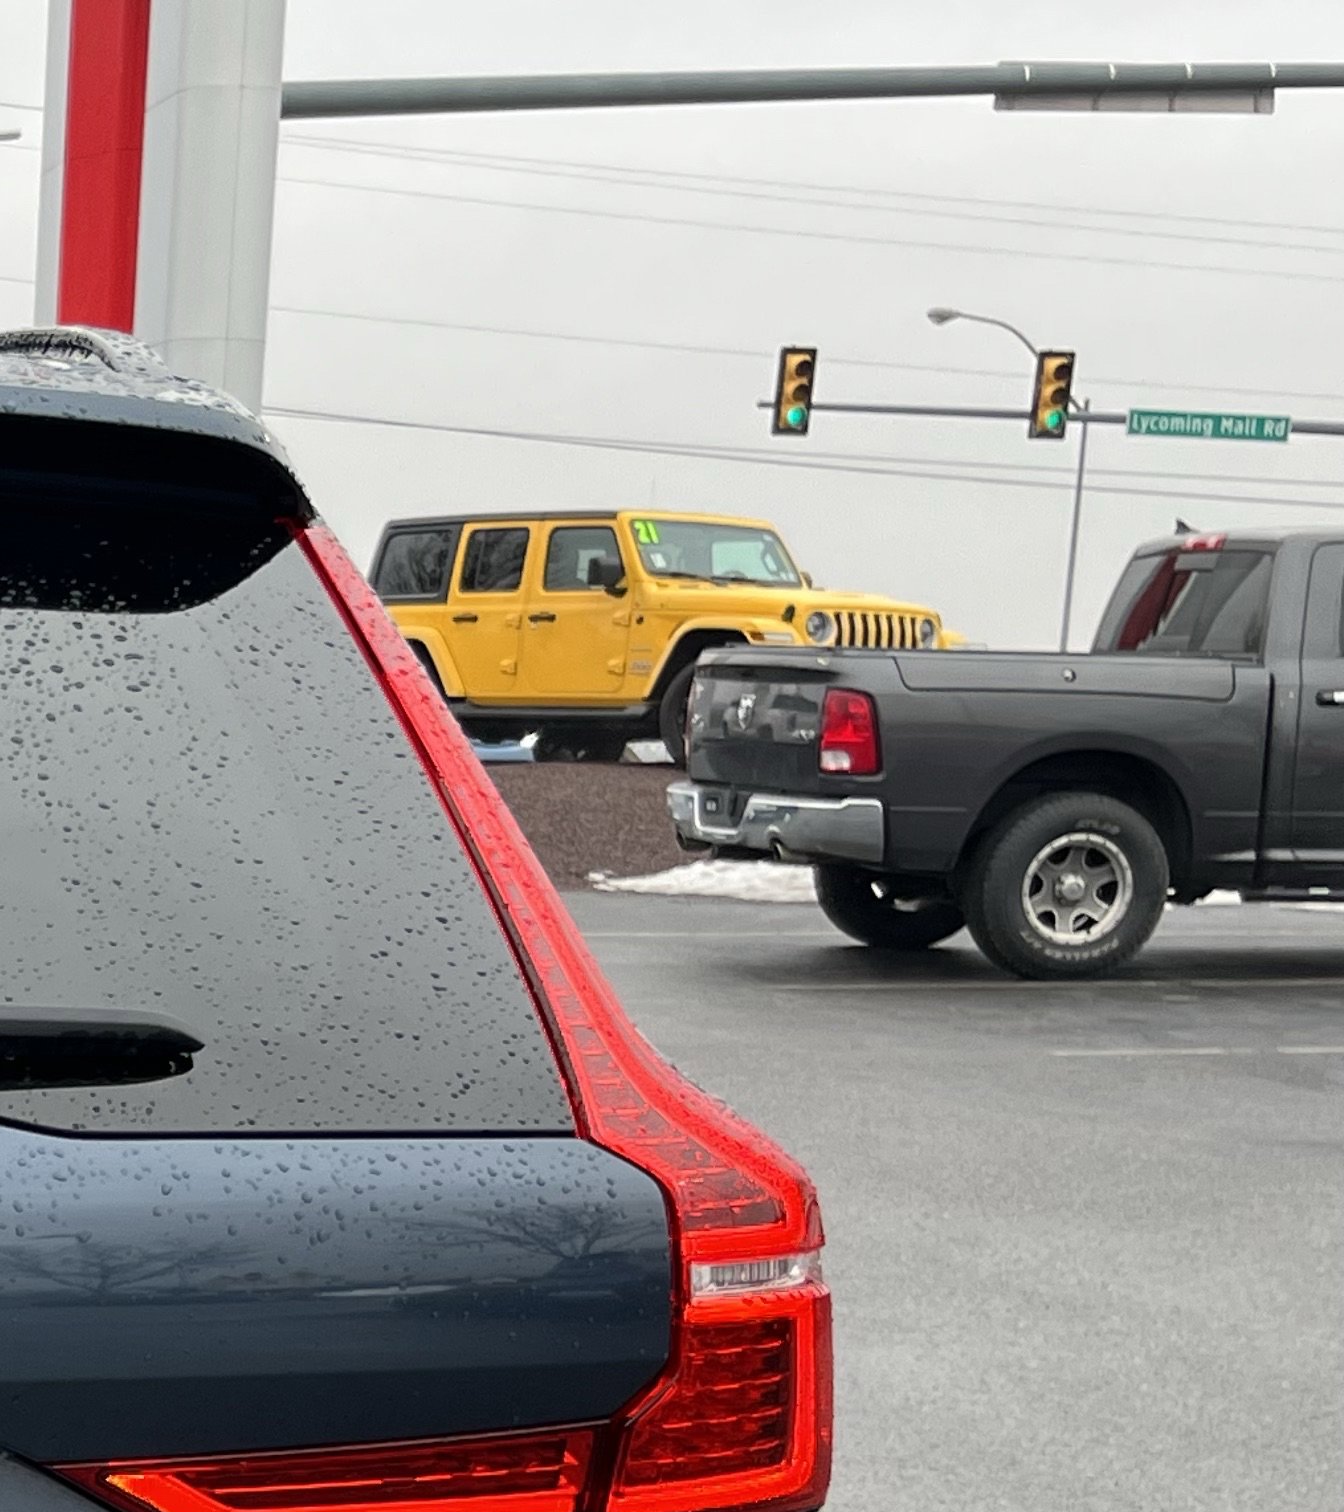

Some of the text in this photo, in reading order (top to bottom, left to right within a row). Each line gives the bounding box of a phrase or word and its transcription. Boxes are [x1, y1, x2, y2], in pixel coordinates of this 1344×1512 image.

[1131, 414, 1287, 438] Lycoming Mall Rd
[634, 521, 659, 544] 21
